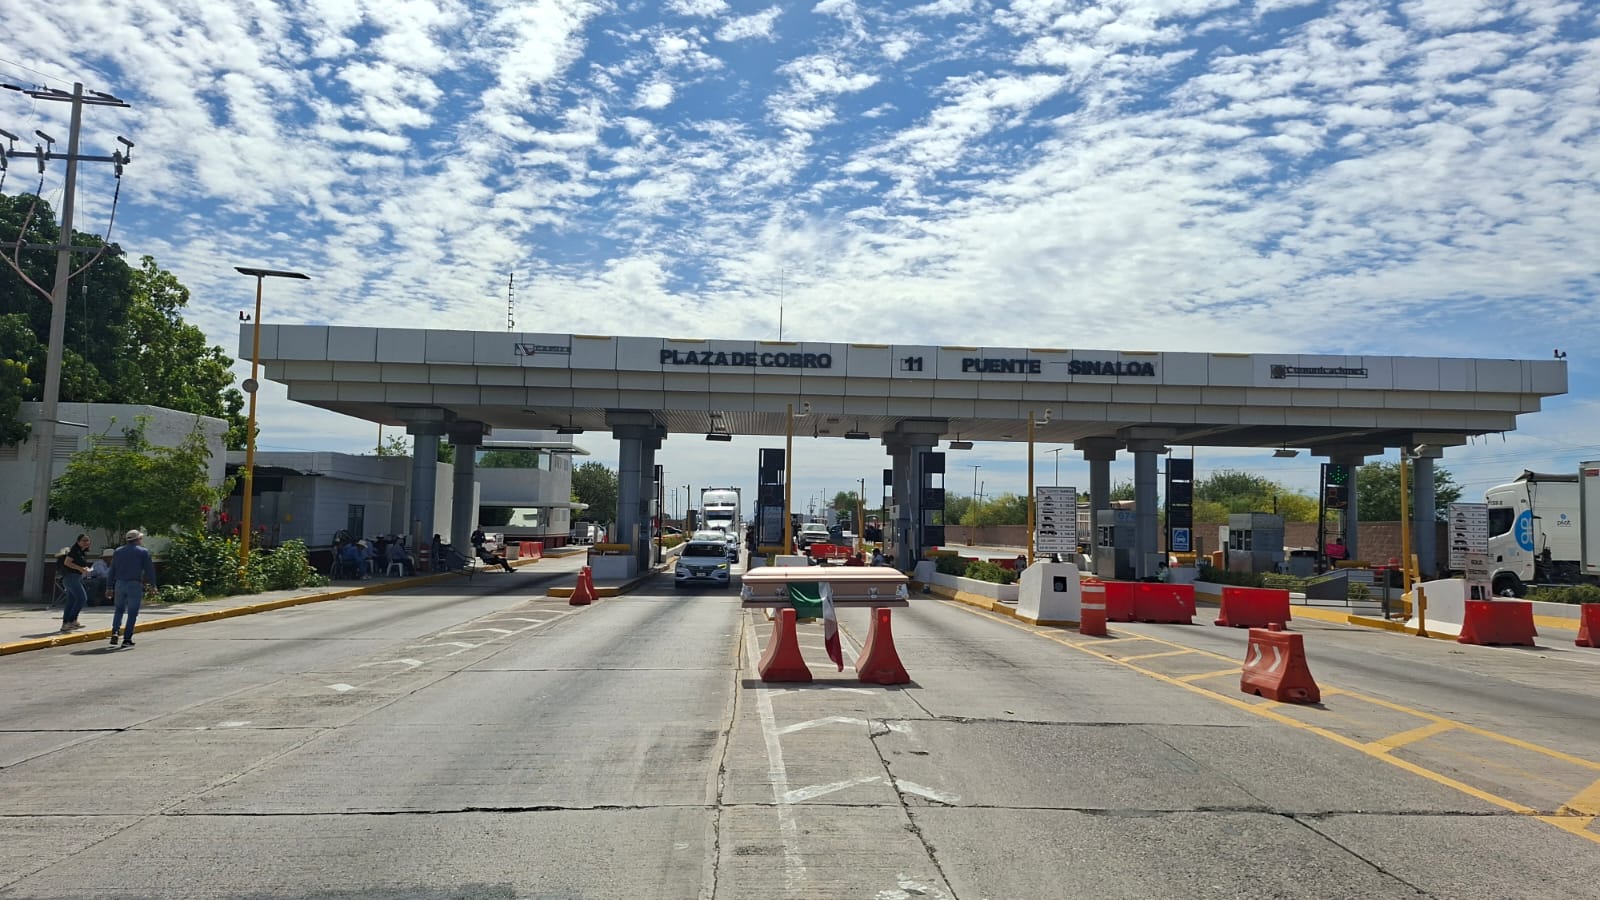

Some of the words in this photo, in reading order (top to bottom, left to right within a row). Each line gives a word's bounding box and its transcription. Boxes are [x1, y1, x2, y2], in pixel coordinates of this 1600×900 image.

[660, 349, 729, 366] PLAZA
[731, 352, 757, 367] DE
[760, 352, 832, 368] COBRO
[904, 356, 923, 371] 11
[961, 358, 1041, 374] PUENTE
[1067, 359, 1155, 376] SINALOA
